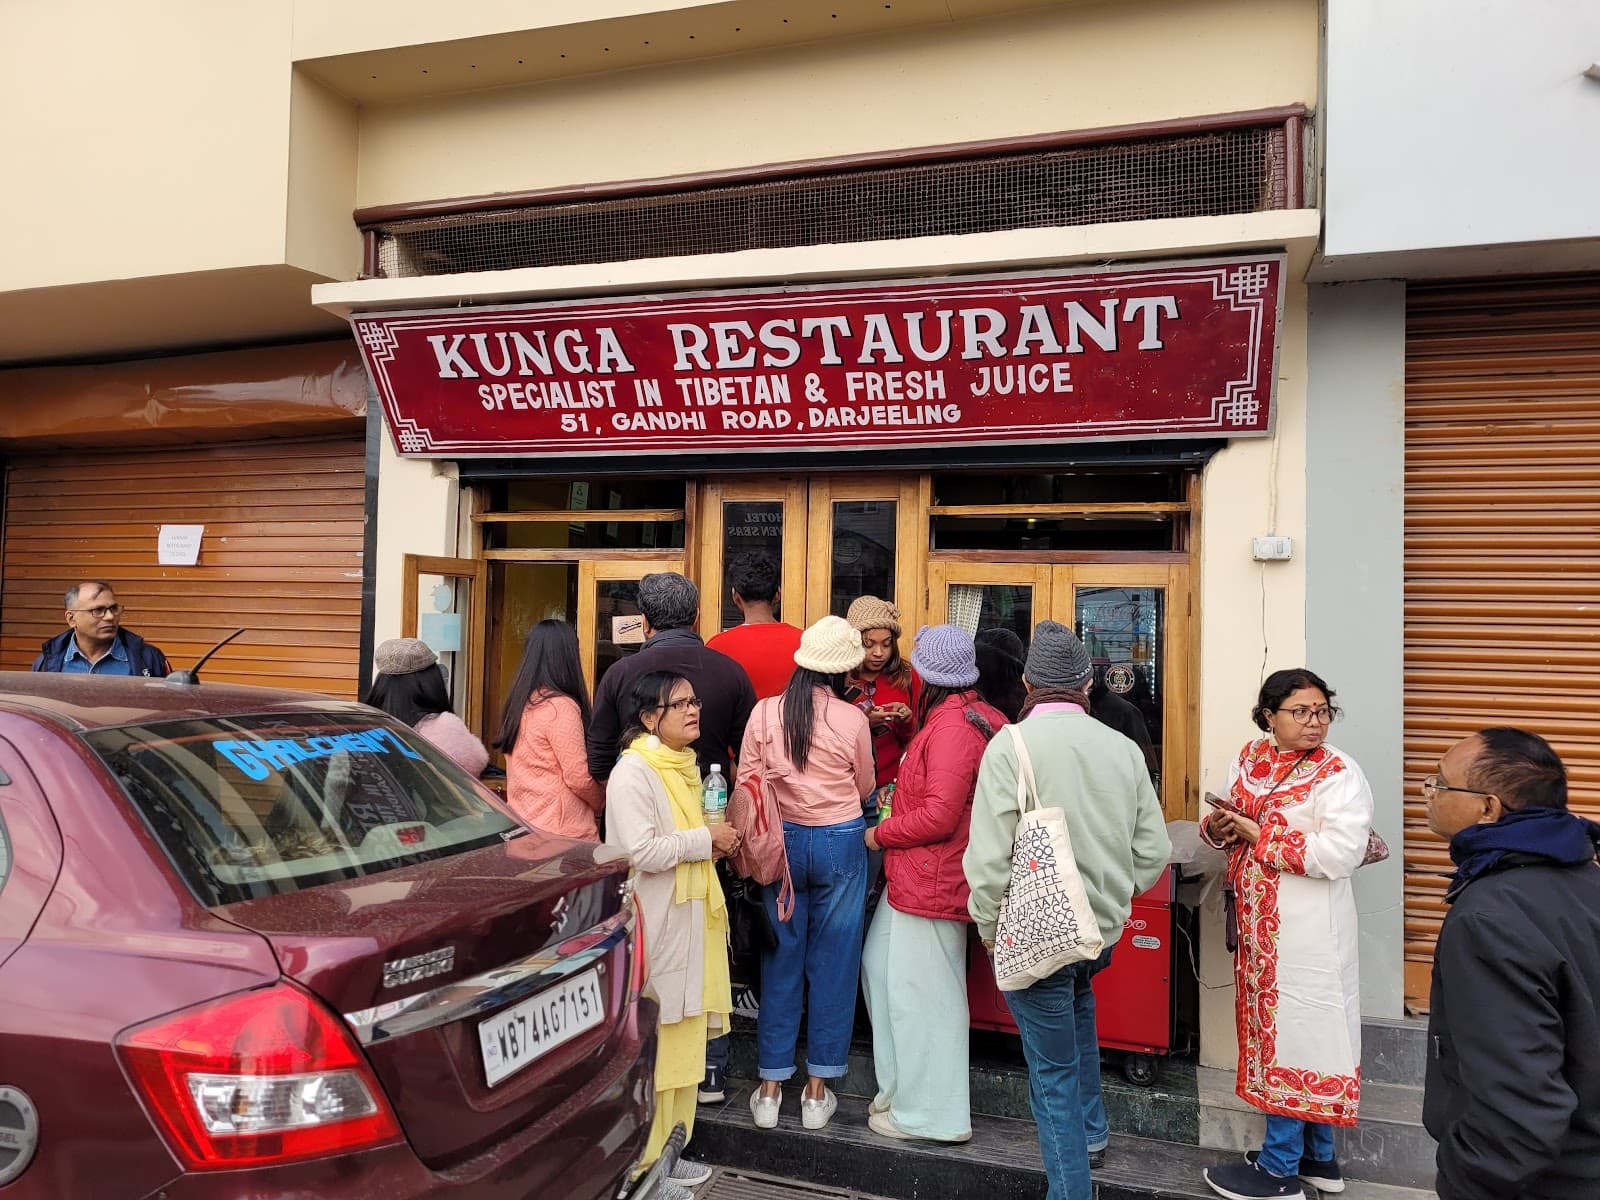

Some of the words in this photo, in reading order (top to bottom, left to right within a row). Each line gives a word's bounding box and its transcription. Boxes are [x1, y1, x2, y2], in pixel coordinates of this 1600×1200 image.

[427, 328, 635, 379] KUNGA
[667, 295, 1179, 371] RESTAURANT
[478, 380, 617, 411] SPECIALIST
[633, 379, 663, 407] IN
[676, 374, 792, 407] TIBETAN
[804, 372, 828, 404] &
[845, 370, 947, 402] FRESH
[970, 362, 1074, 396] JUICE
[611, 411, 707, 431] GANDHI
[808, 403, 962, 428] DARJEELING
[497, 981, 598, 1064] WB74AG7151
